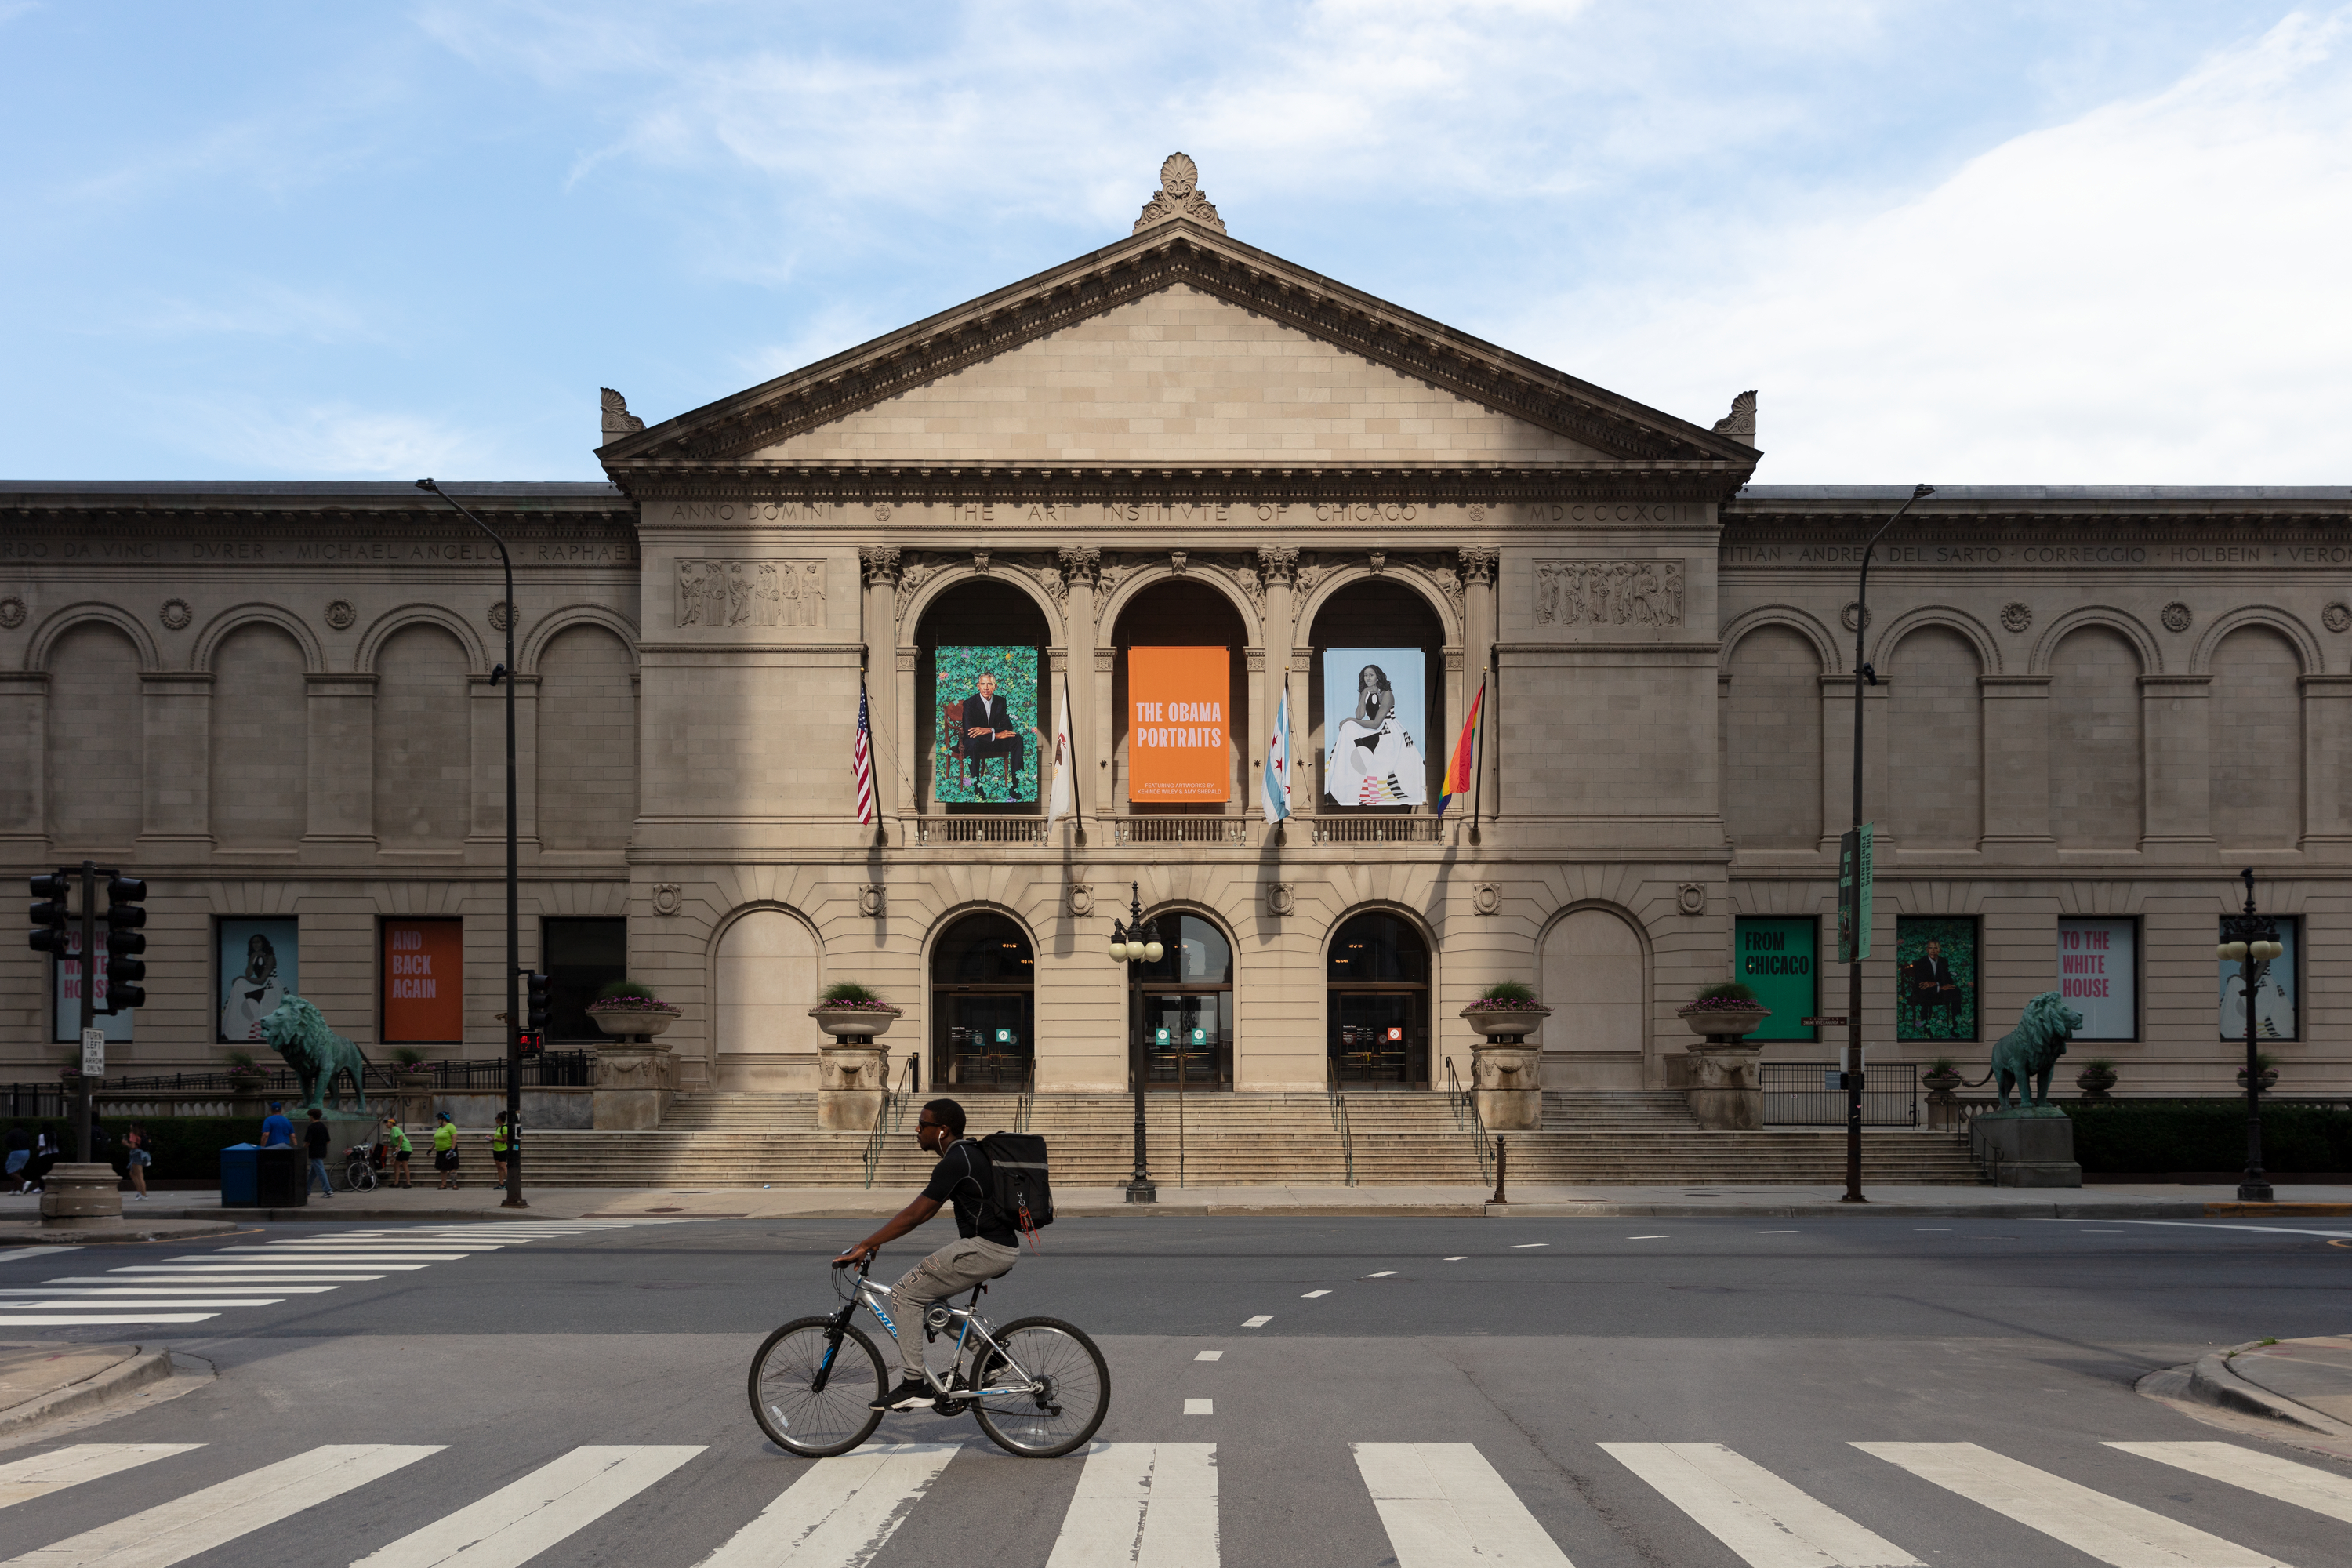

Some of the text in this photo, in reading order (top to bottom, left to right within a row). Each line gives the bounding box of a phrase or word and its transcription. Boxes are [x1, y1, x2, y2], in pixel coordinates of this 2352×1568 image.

[671, 504, 735, 521] ANNO
[748, 504, 833, 521] DOMINI
[949, 505, 995, 521] THE
[1027, 505, 1073, 521] ART
[1103, 505, 1228, 521] INSTITVTE
[1257, 505, 1287, 521] OF
[1316, 505, 1417, 521] CHICAGO
[64, 543, 92, 557] DA
[102, 543, 161, 558] VINCI
[192, 543, 265, 559] DVRER
[297, 543, 399, 559] MICHAEL
[410, 544, 504, 561] ANGELO
[538, 545, 641, 561] RAPHAEL
[1718, 546, 1780, 561] TITIAN
[1798, 547, 1879, 562] ANDREA
[1889, 547, 1929, 562] DEL
[1936, 547, 2001, 562] SARTO
[2024, 547, 2146, 562] CORREGGIO
[2171, 547, 2259, 562] HOLBEIN
[1136, 702, 1221, 722] THE OBAMA
[1138, 728, 1221, 747] PORTRAITS
[393, 931, 422, 950] AND
[1745, 931, 1785, 951] FROM
[2061, 931, 2110, 950] TO THE
[393, 955, 432, 975] BACK
[1745, 955, 1809, 975] CHICAGO
[2063, 954, 2105, 974] WHITE
[392, 978, 436, 999] AGAIN
[2063, 978, 2109, 998] HOUSE
[86, 1031, 103, 1040] TURN
[86, 1040, 102, 1049] LEFT
